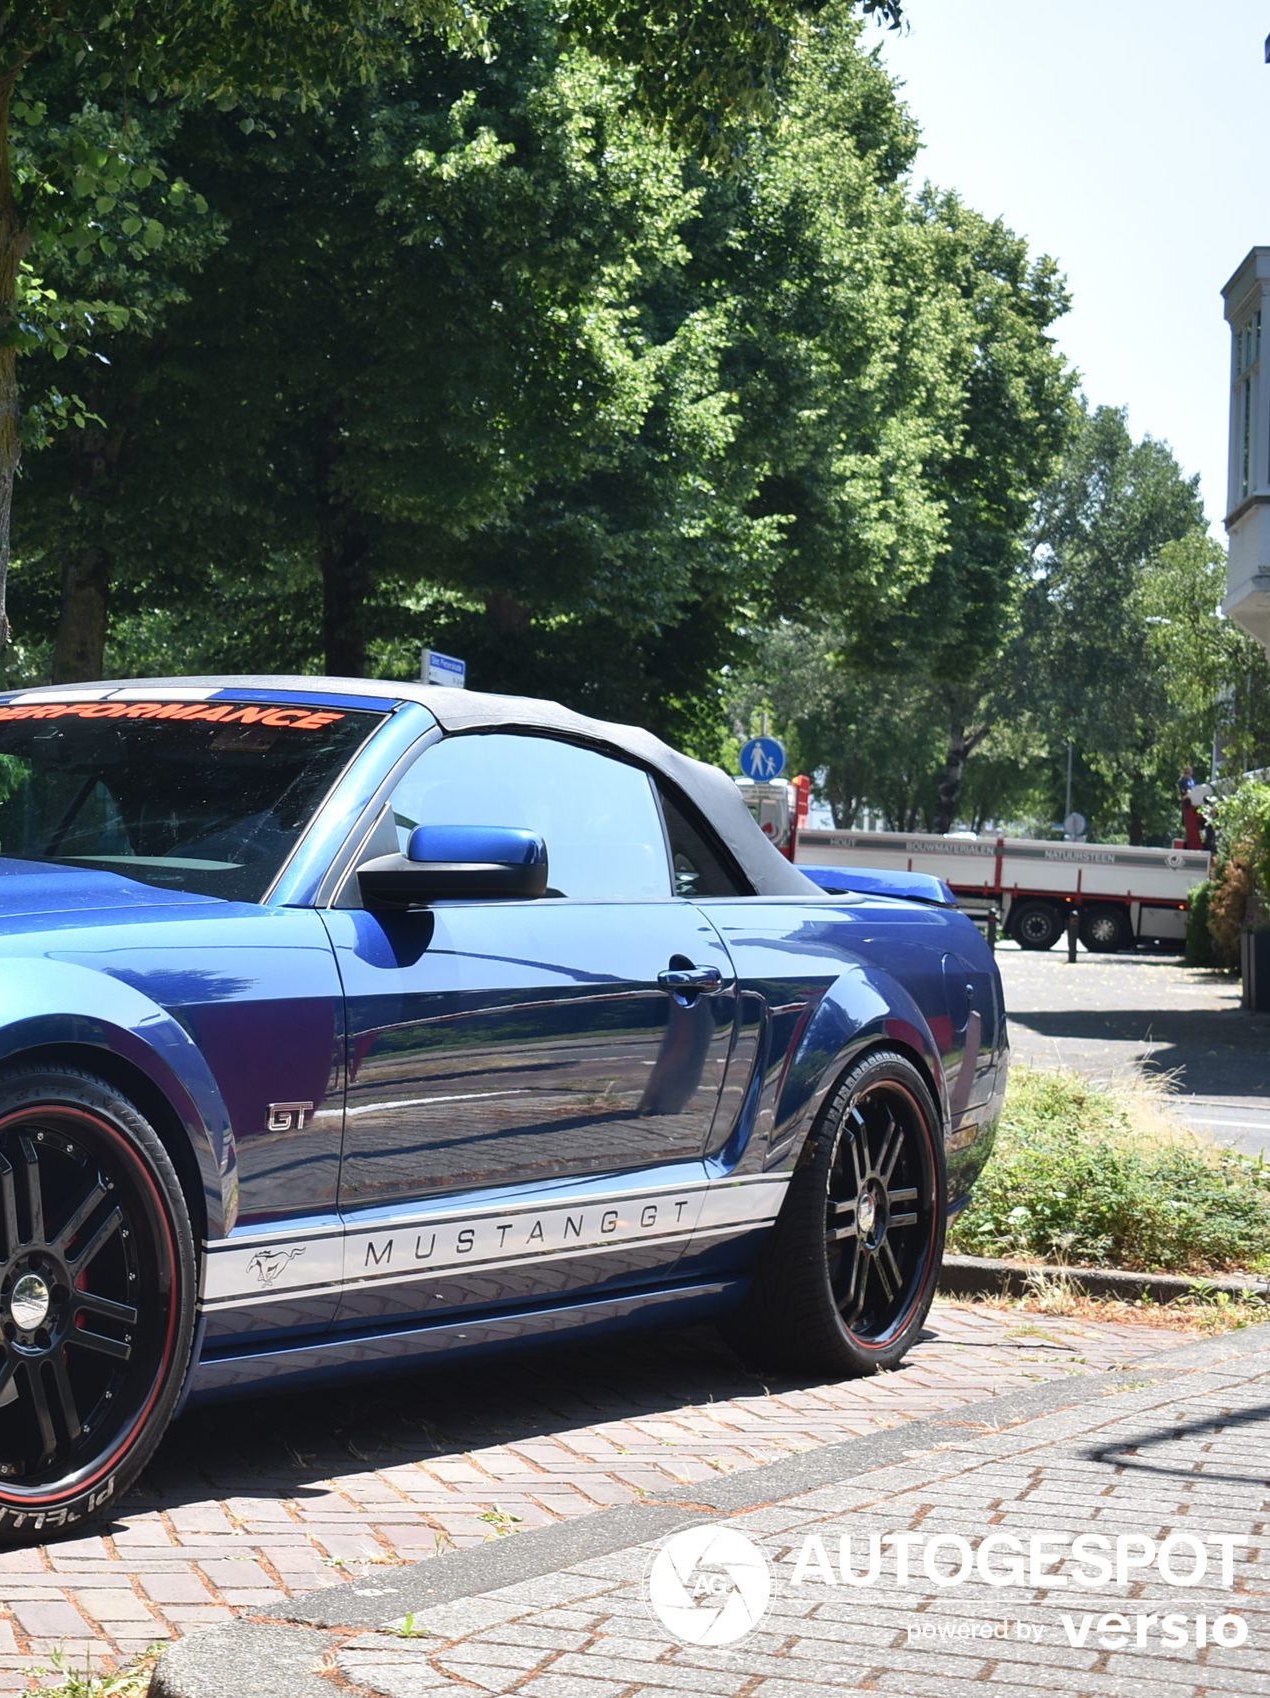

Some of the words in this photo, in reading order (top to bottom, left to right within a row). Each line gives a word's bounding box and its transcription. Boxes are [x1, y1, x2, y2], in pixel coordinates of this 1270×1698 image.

[830, 838, 857, 848] HOUT
[906, 842, 995, 855] BOUWMATERIALEN
[1044, 850, 1115, 863] NATUURSTEEN
[267, 1101, 314, 1131] GT
